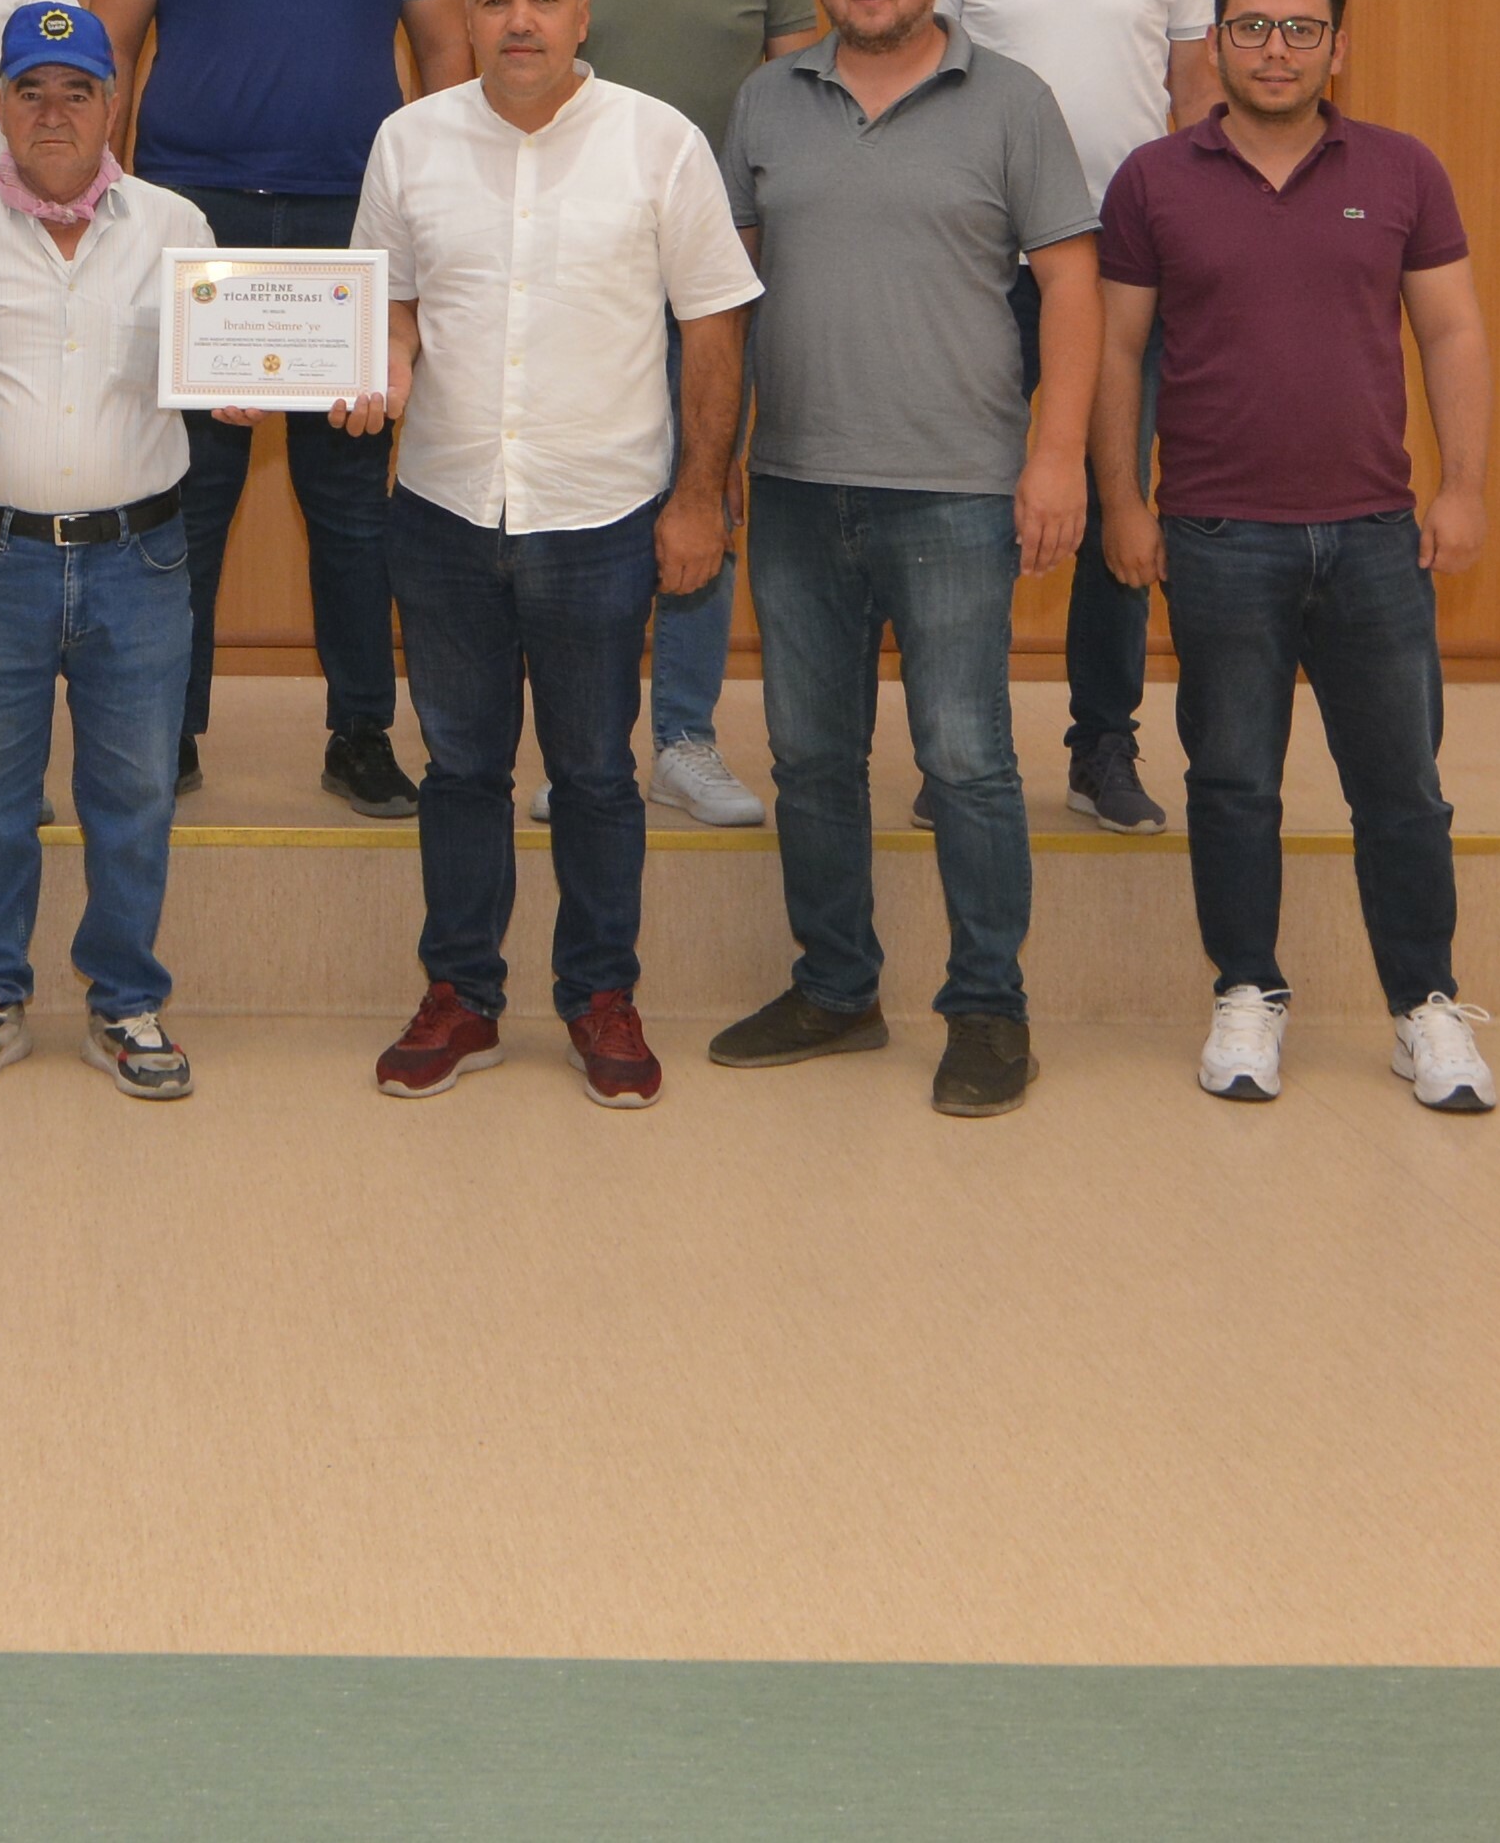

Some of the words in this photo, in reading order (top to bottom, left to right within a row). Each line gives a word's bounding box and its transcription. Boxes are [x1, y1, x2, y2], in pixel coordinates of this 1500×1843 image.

[251, 282, 293, 292] EDİRNE
[224, 292, 270, 302] TİCARET
[275, 294, 322, 302] BORSASI
[224, 320, 265, 330] İbrahim
